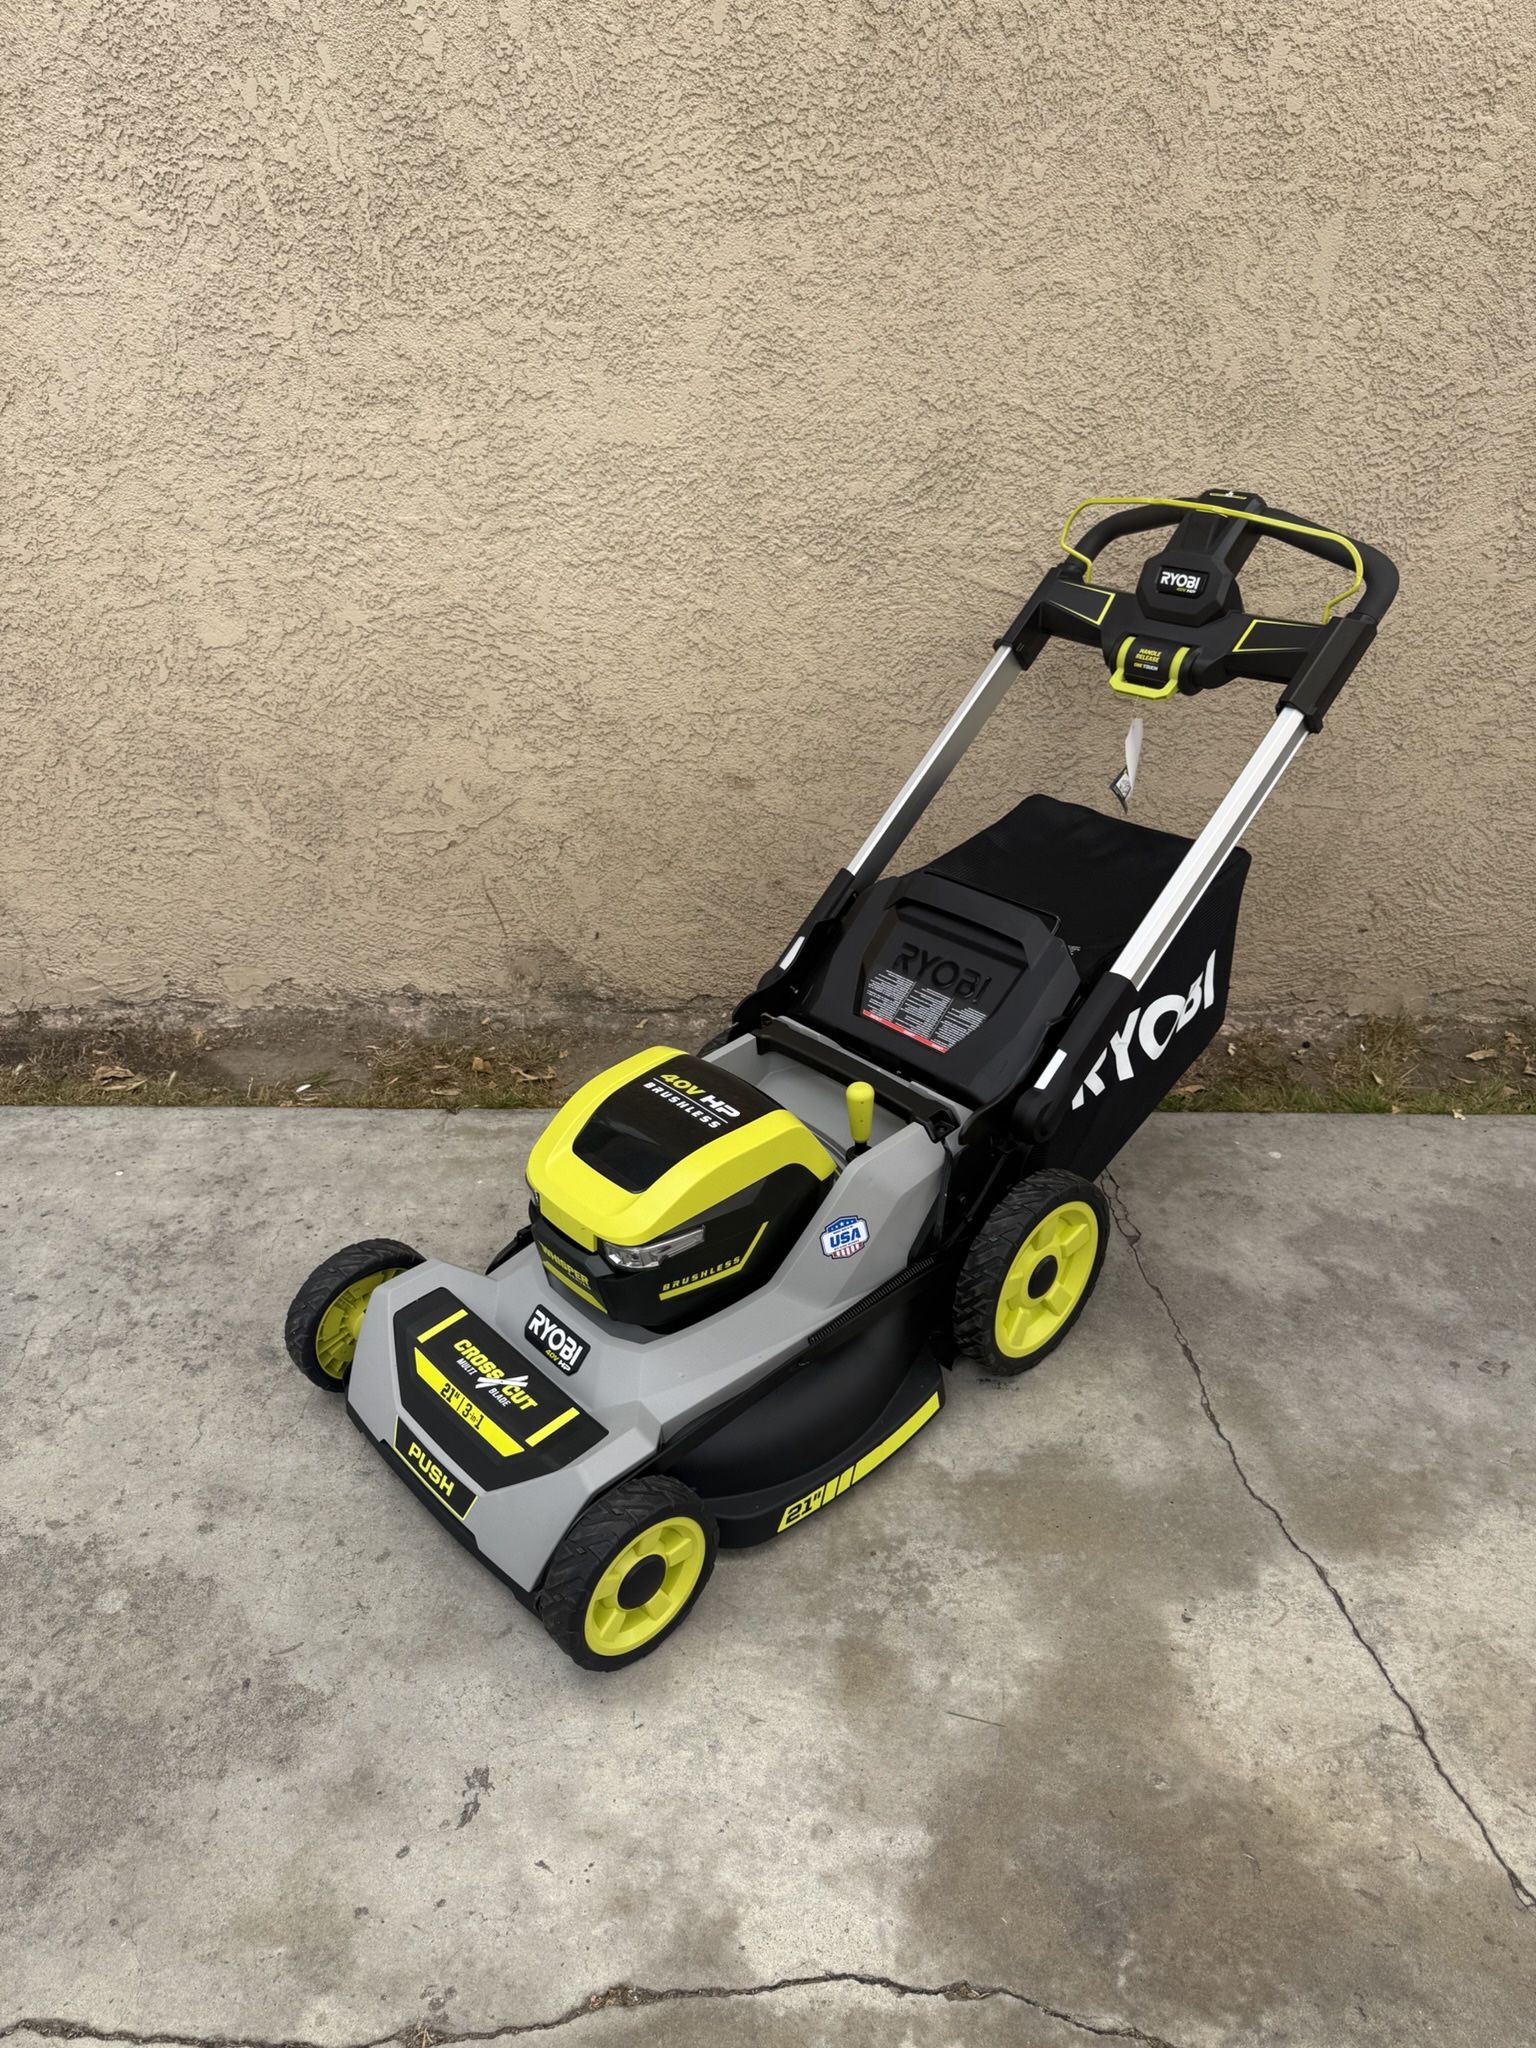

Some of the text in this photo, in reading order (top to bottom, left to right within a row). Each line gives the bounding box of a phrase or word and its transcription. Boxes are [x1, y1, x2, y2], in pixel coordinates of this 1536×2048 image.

[1160, 571, 1201, 590] RYOBI
[1135, 653, 1160, 663] RELEASE
[1139, 648, 1162, 657] HANDLE
[892, 942, 992, 1004] RYOBI
[643, 1082, 721, 1128] BRUSHLESS
[660, 1074, 741, 1117] 40V HP
[830, 1227, 861, 1248] USA
[662, 1256, 741, 1291] BRUSHLESS
[528, 1309, 584, 1367] RYOBI
[456, 1358, 478, 1376] MULTI
[545, 1349, 560, 1362] 40V
[453, 1339, 538, 1410] CROSS CUT
[440, 1383, 460, 1403] 21"
[488, 1387, 511, 1407] BLADE
[408, 1442, 455, 1497] PUSH
[785, 1490, 822, 1525] 21"
